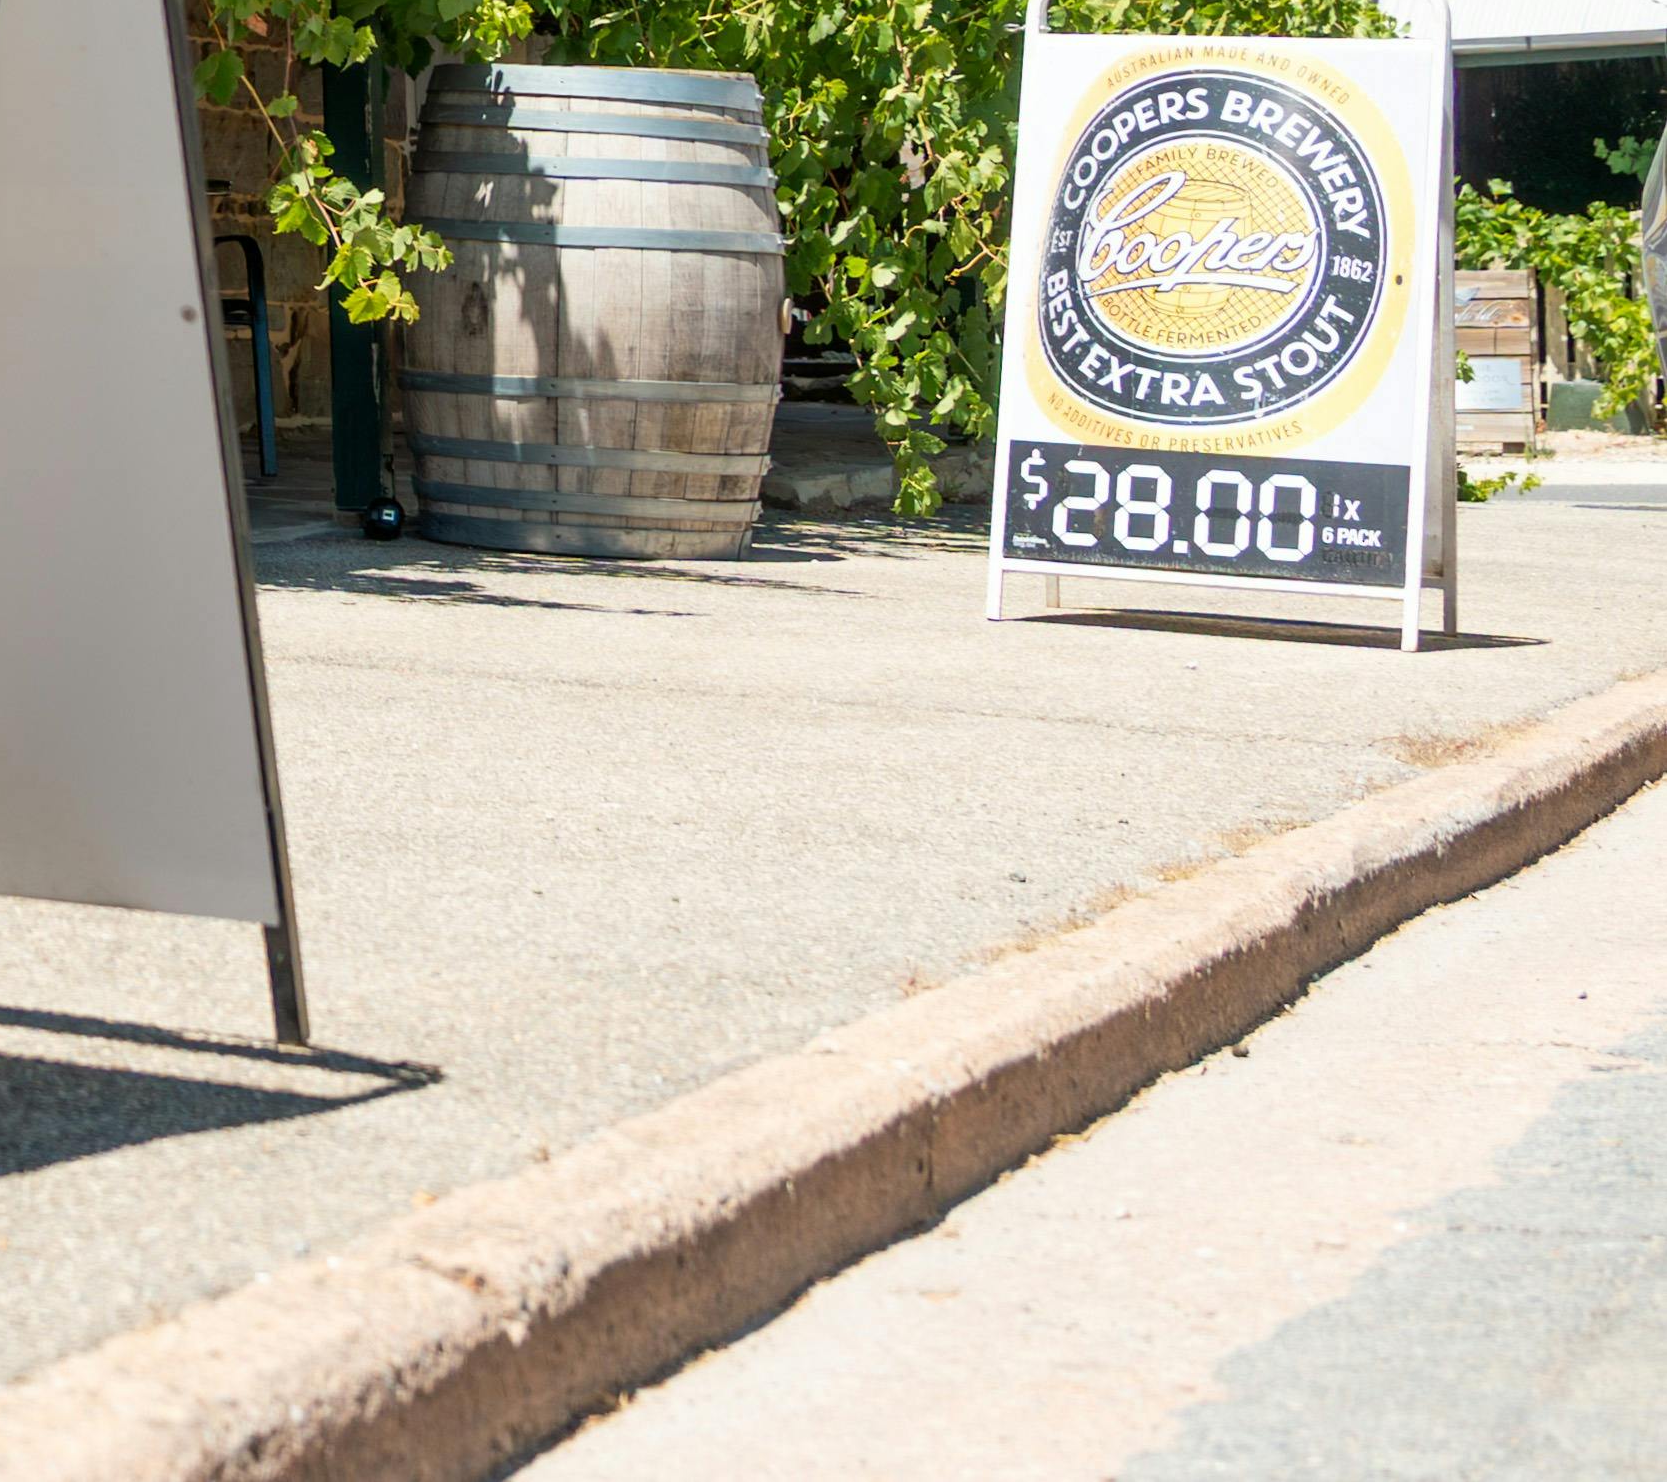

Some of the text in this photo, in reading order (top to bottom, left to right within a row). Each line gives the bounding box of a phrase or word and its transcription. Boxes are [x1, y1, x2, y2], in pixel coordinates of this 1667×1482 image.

[1108, 45, 1350, 105] AUSTRALIAN MADE AND OWNED
[1063, 87, 1371, 239] COOPERS BREWERY
[1136, 147, 1279, 188] FAMILY BREWED
[1078, 170, 1322, 294] Coopers
[1331, 255, 1374, 282] 1862
[1046, 269, 1355, 407] BEST EXTRA STOUT
[1102, 296, 1262, 345] BOTTLE FERMENTED
[1063, 405, 1134, 446] ADDITIVES
[1140, 433, 1161, 452] OR
[1170, 420, 1304, 453] PRESERVATIVES
[1321, 526, 1382, 548] 6 PACK
